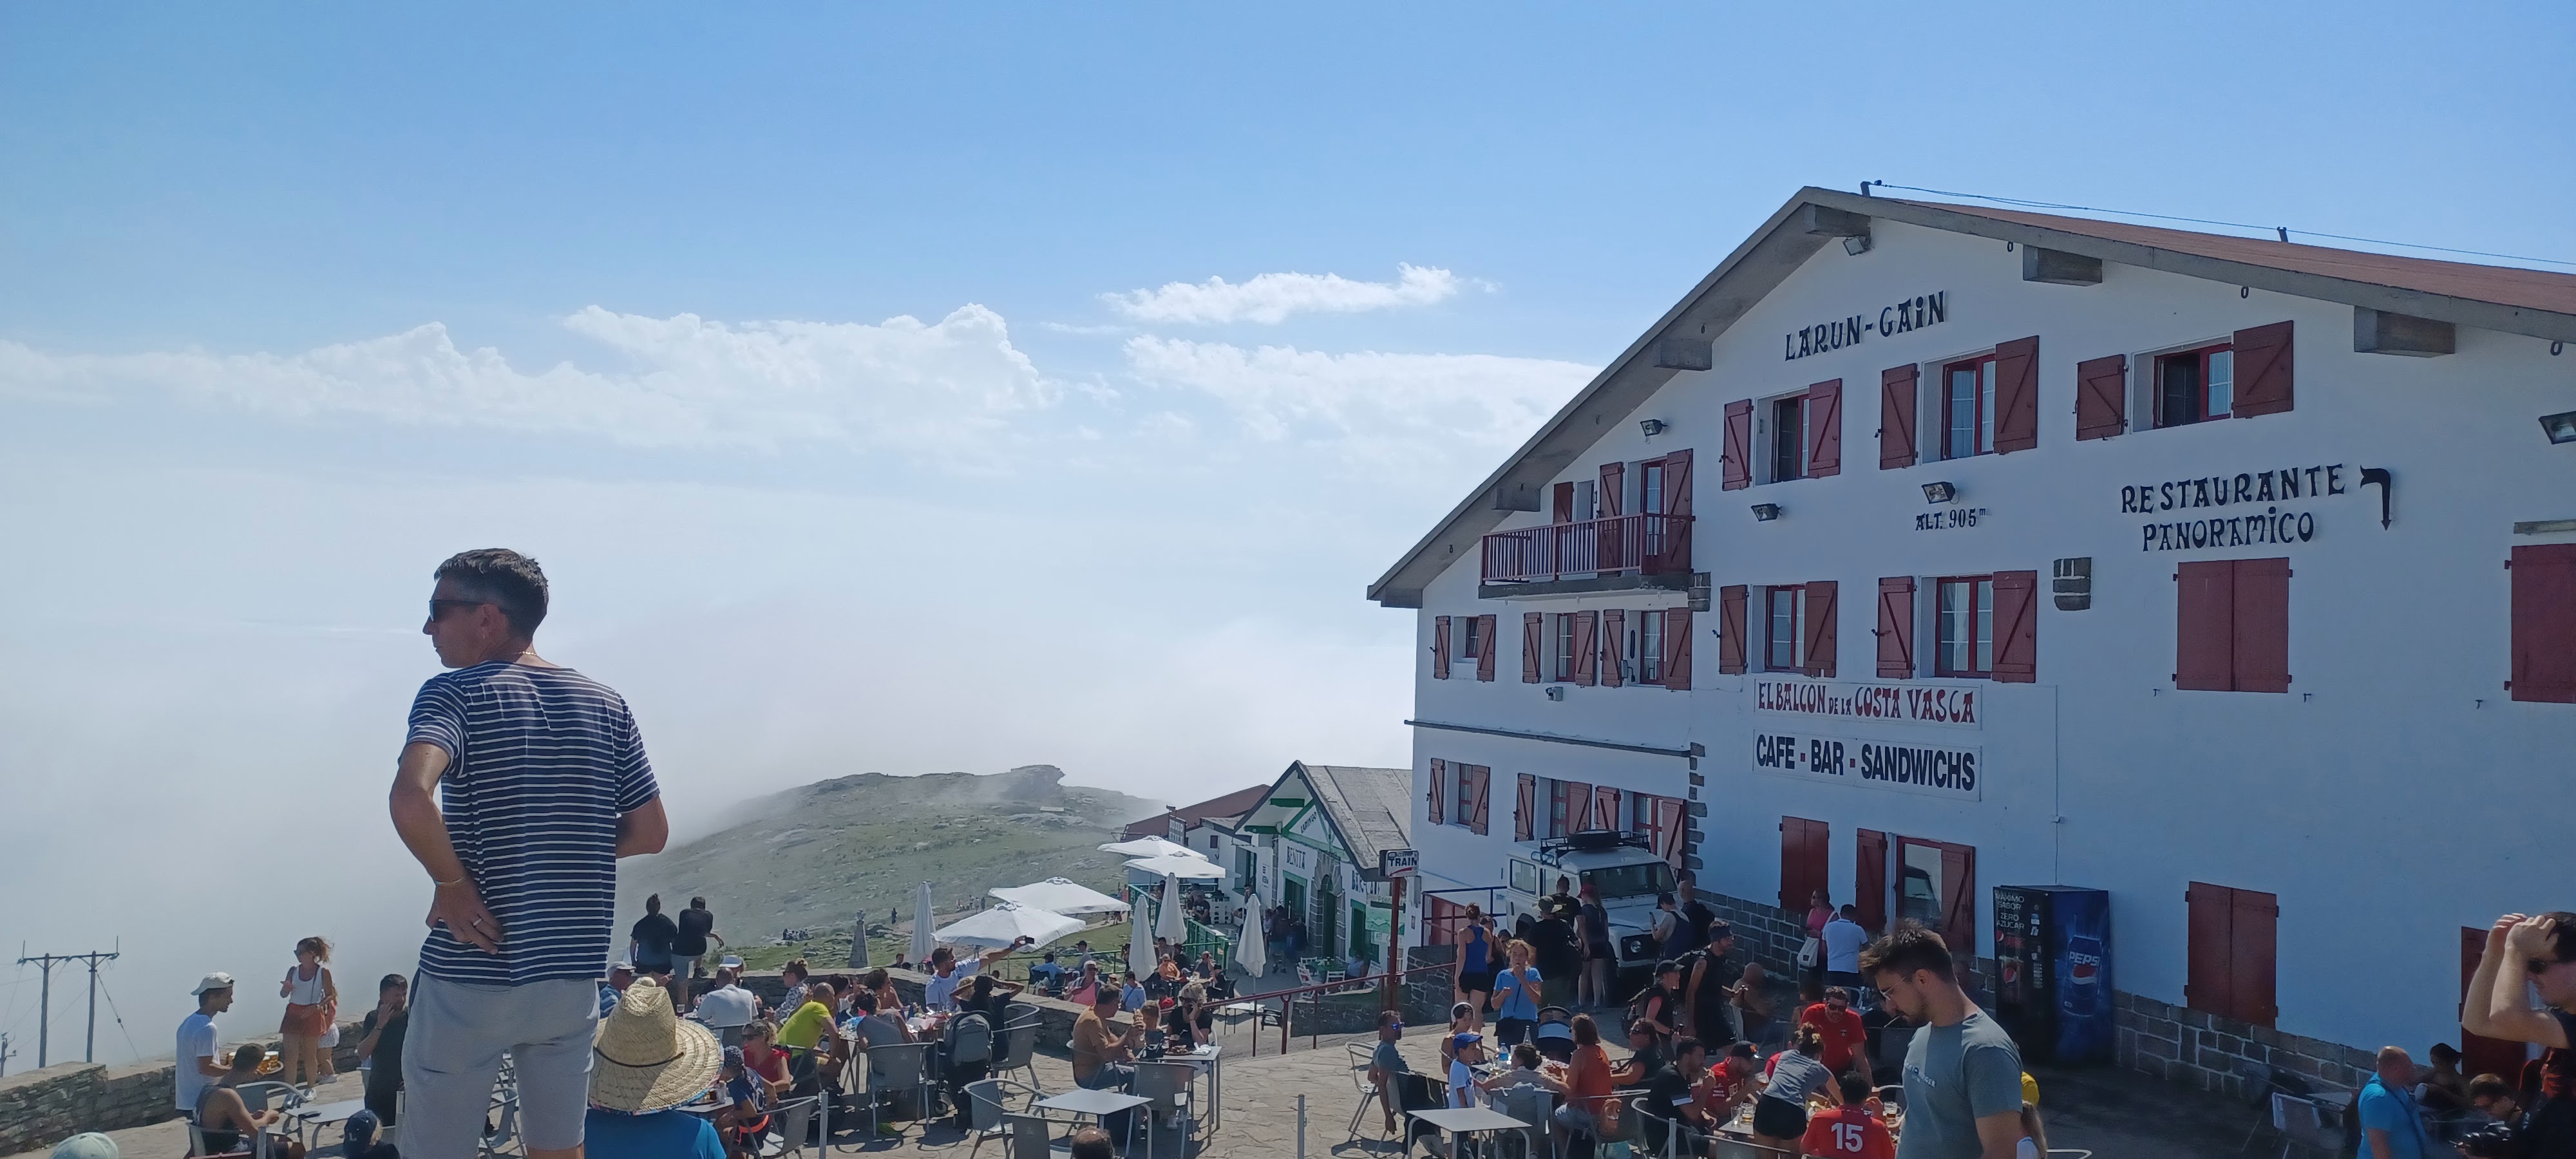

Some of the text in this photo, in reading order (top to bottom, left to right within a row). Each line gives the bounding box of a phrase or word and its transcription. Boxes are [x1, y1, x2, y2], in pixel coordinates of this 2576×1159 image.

[2121, 463, 2345, 514] RESTAURANTE
[1915, 511, 1942, 531] ALT.
[1758, 682, 1975, 724] EL BALCON DE LA COSTA VASCA
[1756, 734, 1975, 791] CAFE BAR SANDWICHS
[1388, 857, 1417, 867] TRAIN
[2000, 912, 2020, 921] ZERO
[1831, 1122, 1864, 1153] 15
